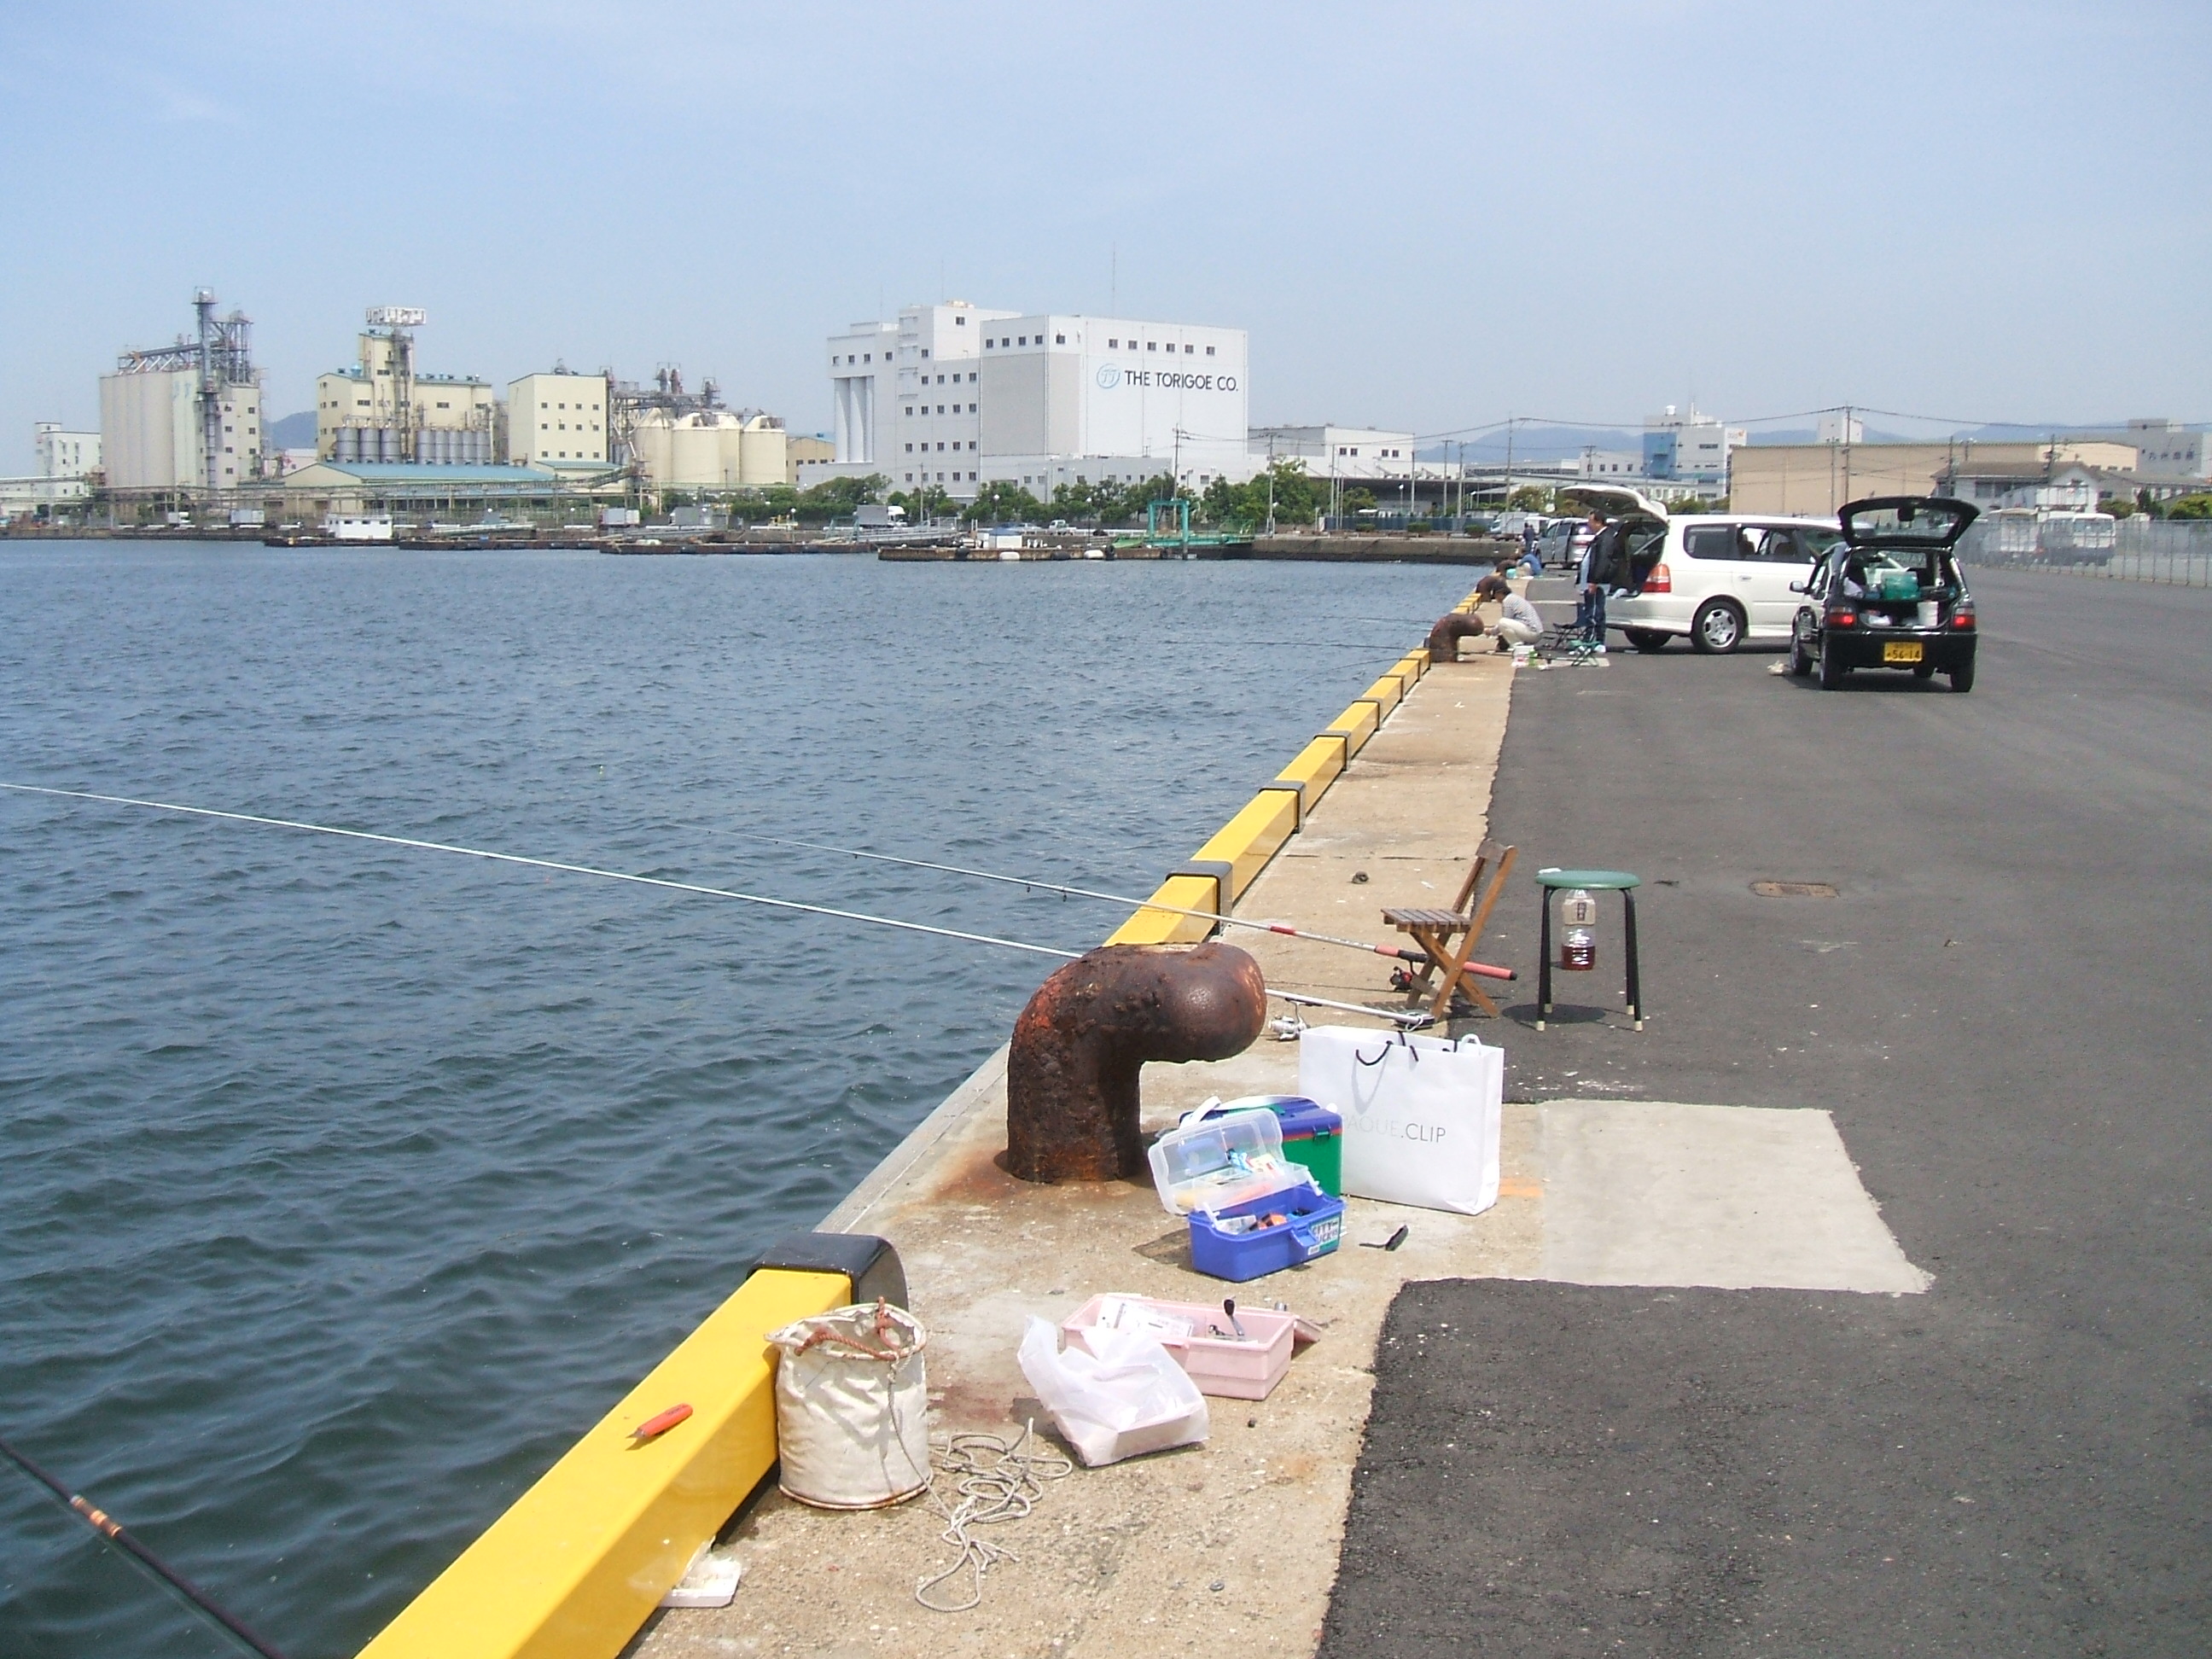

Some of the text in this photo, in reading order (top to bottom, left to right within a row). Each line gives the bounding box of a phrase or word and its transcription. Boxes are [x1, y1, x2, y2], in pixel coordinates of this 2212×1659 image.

[1124, 370, 1239, 392] THE TORIGOE CO.
